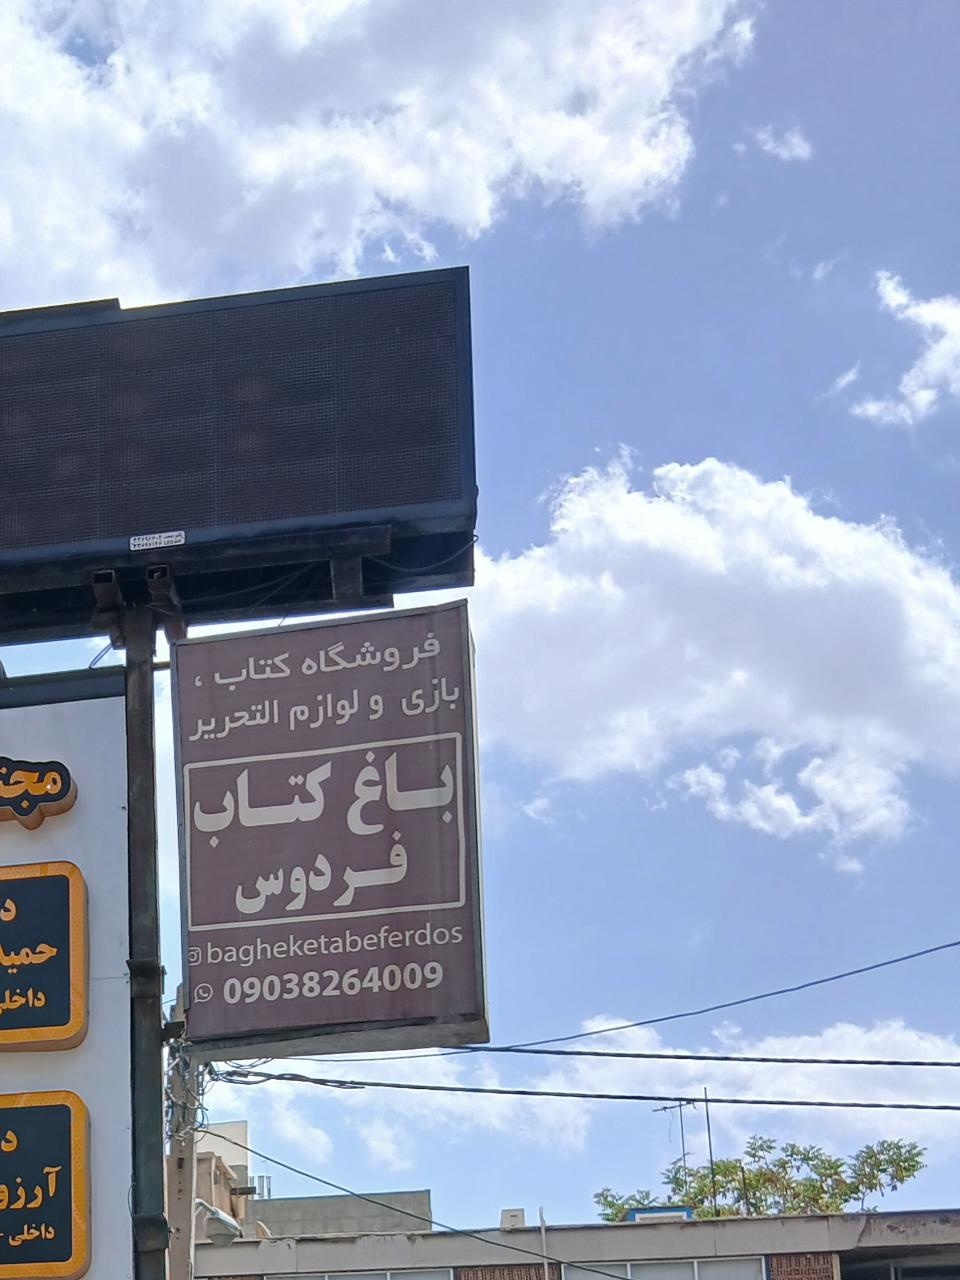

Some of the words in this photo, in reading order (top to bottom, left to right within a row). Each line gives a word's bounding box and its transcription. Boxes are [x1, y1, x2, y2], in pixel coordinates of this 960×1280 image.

[215, 653, 290, 690] کتاب
[302, 633, 440, 674] فروشگاه
[290, 689, 358, 730] لوازم
[370, 695, 383, 719] و
[402, 678, 459, 715] بازی
[189, 700, 278, 741] التحریر
[192, 760, 331, 847] کتاب
[346, 749, 453, 836] باغ
[236, 830, 408, 915] فردوس
[206, 922, 462, 968] bagheketabeferdos
[224, 960, 443, 1003] 09038264009
[9, 1224, 54, 1246] داخلی
